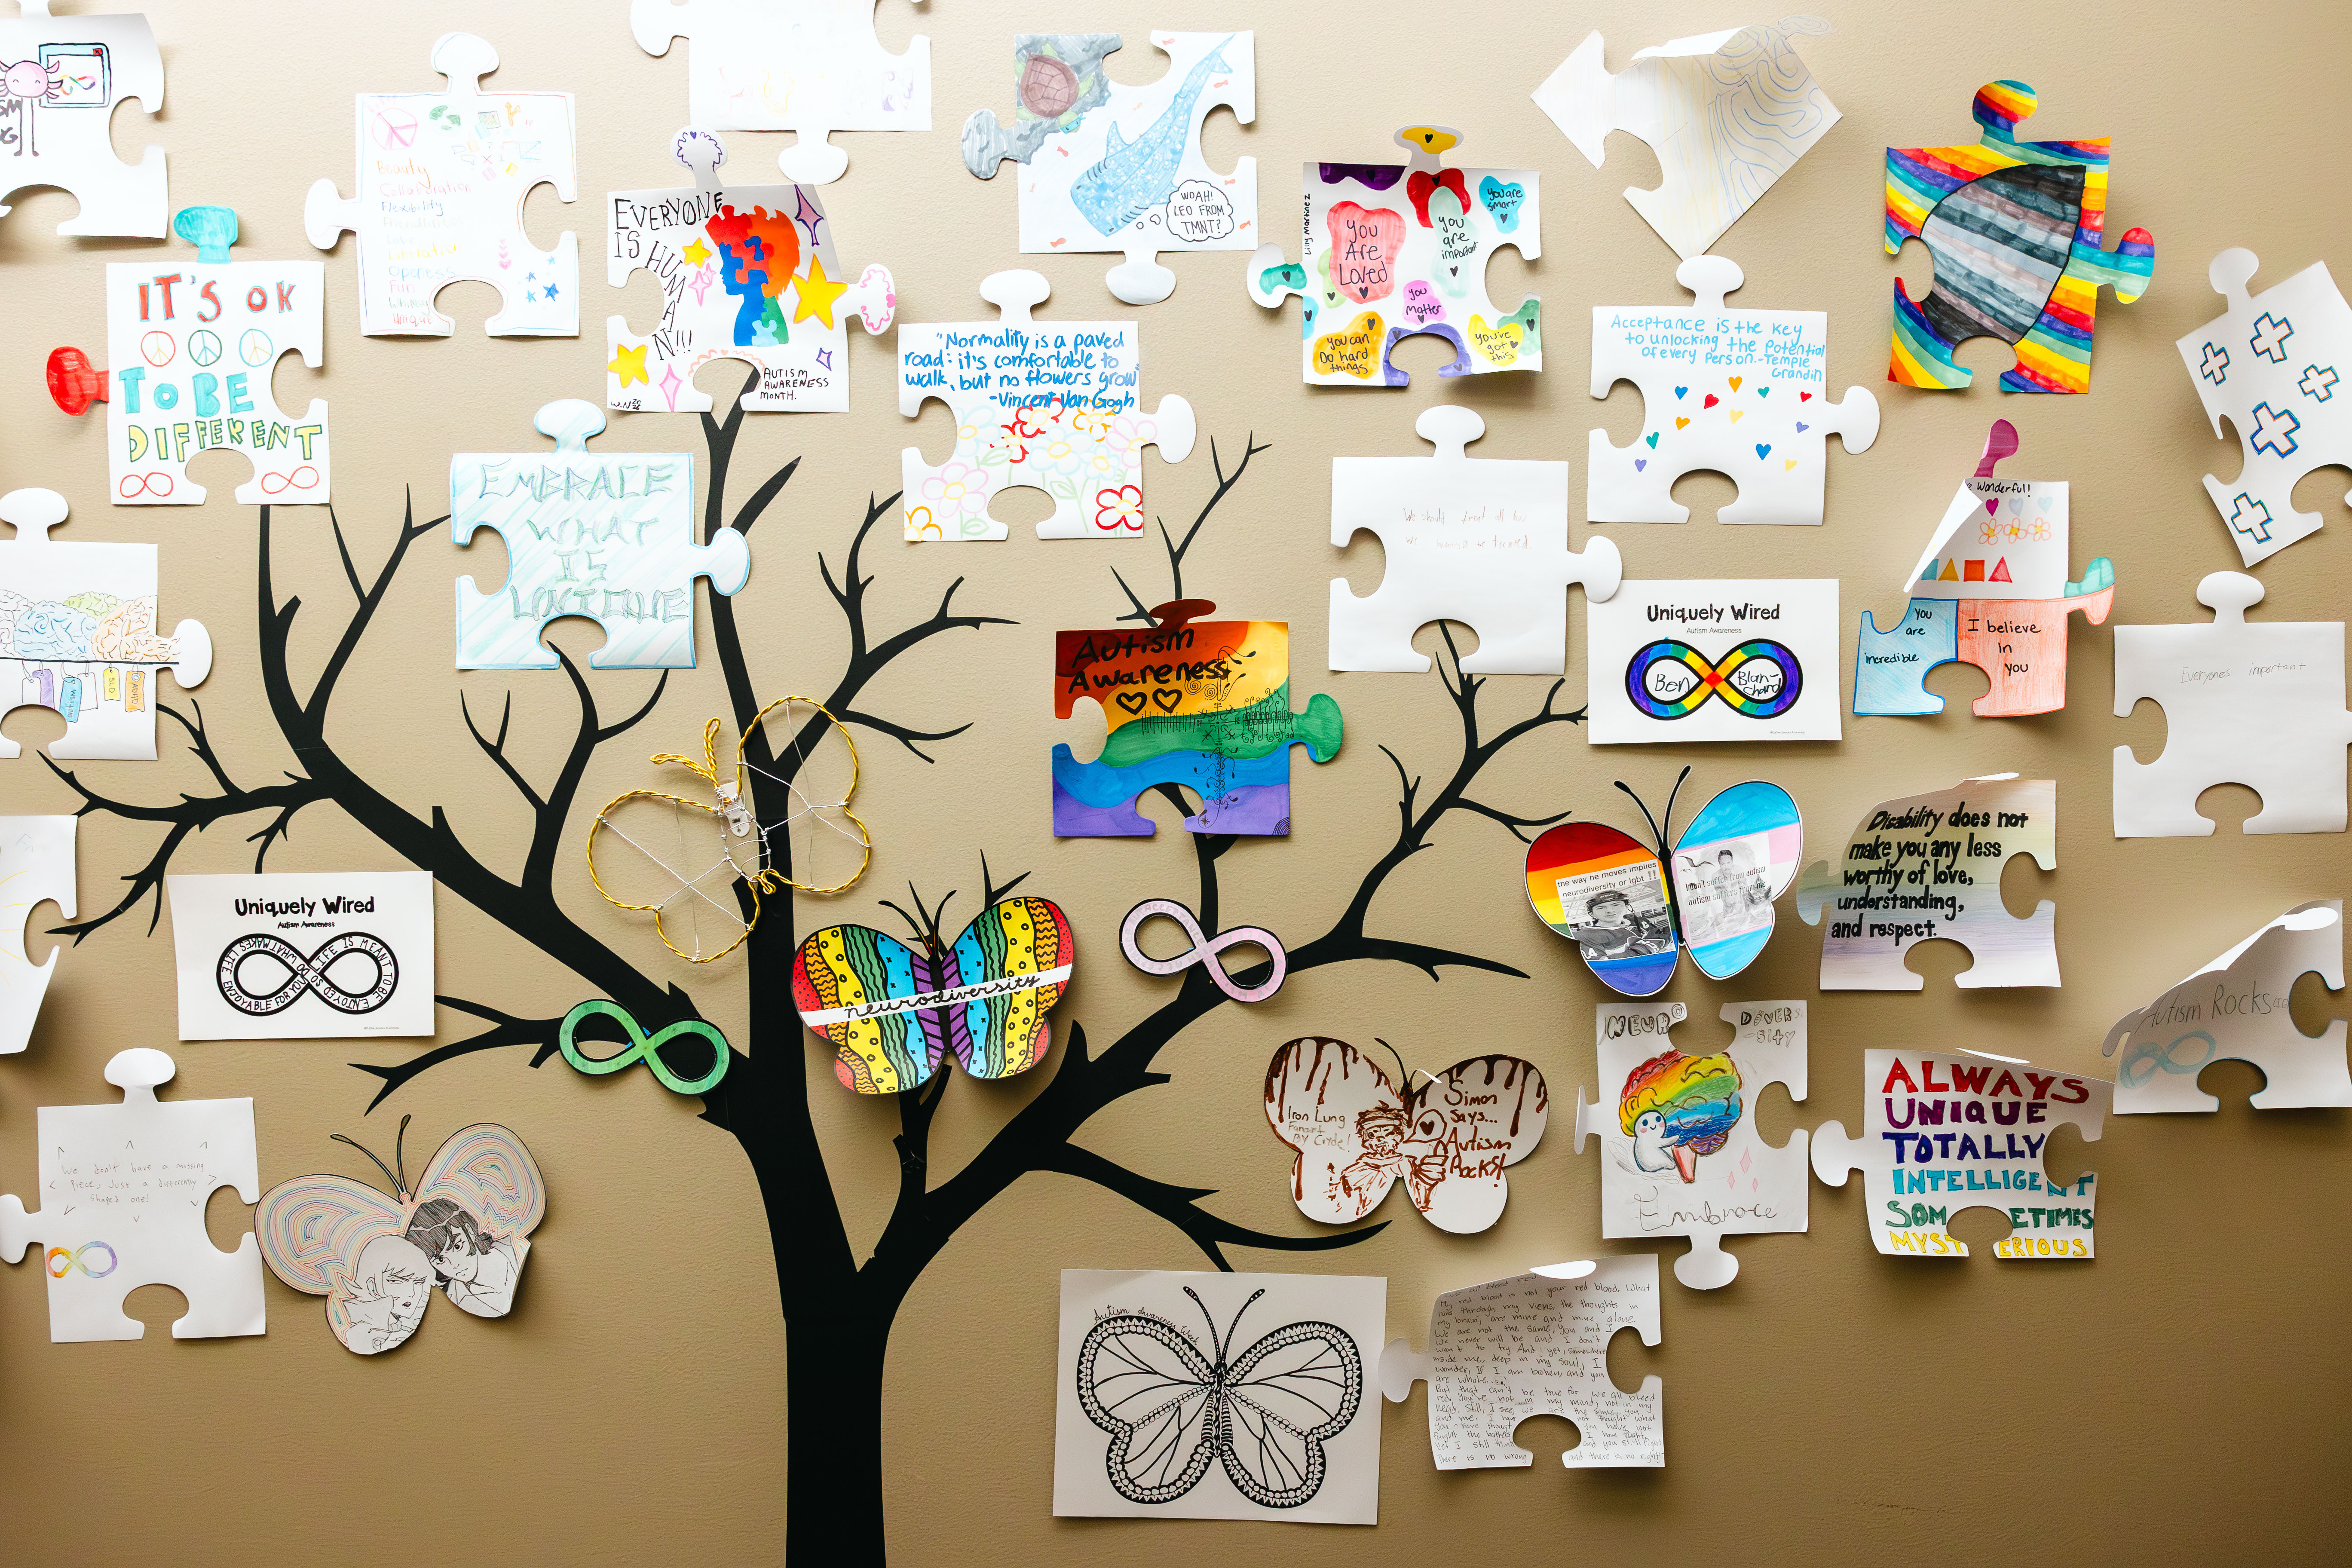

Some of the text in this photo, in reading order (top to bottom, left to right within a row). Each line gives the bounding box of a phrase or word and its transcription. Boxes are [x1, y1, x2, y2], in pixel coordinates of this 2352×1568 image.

[377, 158, 431, 189] Beauty
[380, 181, 471, 197] Collaboration
[1181, 191, 1214, 202] WOAH!
[382, 201, 443, 216] Flexibility
[614, 192, 723, 231] EVERYONE
[1174, 205, 1225, 215] LEO FROM
[1488, 200, 1517, 211] smart
[1182, 220, 1221, 234] TMNT?
[614, 230, 640, 258] IS
[1442, 242, 1478, 259] important
[1443, 233, 1470, 248] are
[1345, 243, 1382, 260] Are
[1340, 260, 1387, 285] Loved
[389, 279, 415, 293] Fun
[138, 273, 296, 322] IT'S OK
[1611, 314, 1763, 334] Acceptance the
[1035, 334, 1049, 349] is
[1054, 336, 1066, 347] a
[1074, 331, 1124, 352] paved
[1348, 334, 1370, 345] can
[1487, 343, 1507, 355] got
[1626, 333, 1644, 345] to
[1650, 334, 1719, 352] unlocking
[1727, 337, 1757, 352] the
[905, 350, 1118, 370] road: it's comfortable to
[1340, 348, 1368, 361] hard
[1491, 352, 1514, 362] this
[1660, 349, 1697, 364] every
[763, 368, 808, 380] AUTISM
[1330, 363, 1368, 374] things
[1771, 368, 1822, 382] Grandin
[764, 378, 829, 389] AWARENESS
[905, 370, 955, 391] walk,
[960, 372, 992, 390] but
[999, 374, 1019, 386] no
[1025, 371, 1091, 386] flowers
[193, 372, 255, 418] BE
[1060, 390, 1089, 407] Van
[1092, 392, 1134, 413] Gogh
[129, 418, 322, 462] DIFFERENT
[479, 458, 675, 502] EMBRACE
[1403, 506, 1504, 526] We should treat all
[526, 511, 659, 546] WHAT
[553, 548, 608, 587] IS
[509, 585, 689, 624] UNIQUE
[1648, 603, 1780, 623] Uniquely Wired
[1905, 627, 1925, 635] are
[1968, 619, 2041, 634] I believe
[1072, 628, 1195, 668] Autism
[1998, 643, 2012, 653] in
[1865, 652, 1919, 665] incredible
[1068, 657, 1231, 694] Awareness
[1656, 674, 1690, 692] Ben
[2180, 662, 2306, 685] Everyones important
[67, 689, 76, 718] autism
[1866, 801, 2028, 837] Disability does not
[1849, 832, 2001, 869] make you any less
[1558, 879, 1570, 888] the
[1572, 876, 1586, 885] way
[1602, 869, 1627, 878] moves
[1629, 861, 1657, 874] implies
[1730, 867, 1766, 881] from autism
[1844, 859, 1974, 893] worthy of love,
[1562, 882, 1616, 898] neurodiversity
[235, 896, 374, 917] Uniquely Wired
[1688, 896, 1710, 906] autism
[1838, 885, 1964, 921] understanding,
[1831, 913, 1937, 946] and respect.
[342, 936, 353, 948] IS
[309, 945, 338, 971] LIFE
[360, 938, 392, 967] MEANT
[383, 973, 392, 985] TO
[223, 980, 272, 1011] ENJOYABLE
[275, 992, 291, 1006] FOR
[372, 987, 387, 1001] BE
[845, 974, 1040, 1019] neurodiversity
[2135, 980, 2272, 1034] Autism Rocks
[1882, 1057, 2089, 1104] ALWAYS
[1444, 1079, 1497, 1106] Simon
[1289, 1106, 1345, 1129] Iron Lung
[1885, 1098, 2048, 1129] UNIQUE
[1445, 1125, 1512, 1155] Autism
[1882, 1132, 2046, 1164] TOTALLY
[131, 1162, 151, 1172] have
[176, 1163, 204, 1172] missing
[1547, 1285, 1567, 1298] your
[1626, 1283, 1651, 1292] What
[1580, 1299, 1618, 1313] thoughts
[1093, 1304, 1201, 1346] Autism Awareness Week
[1544, 1312, 1563, 1322] and
[1585, 1323, 1600, 1332] and
[1488, 1334, 1503, 1342] will
[1492, 1354, 1511, 1364] deep
